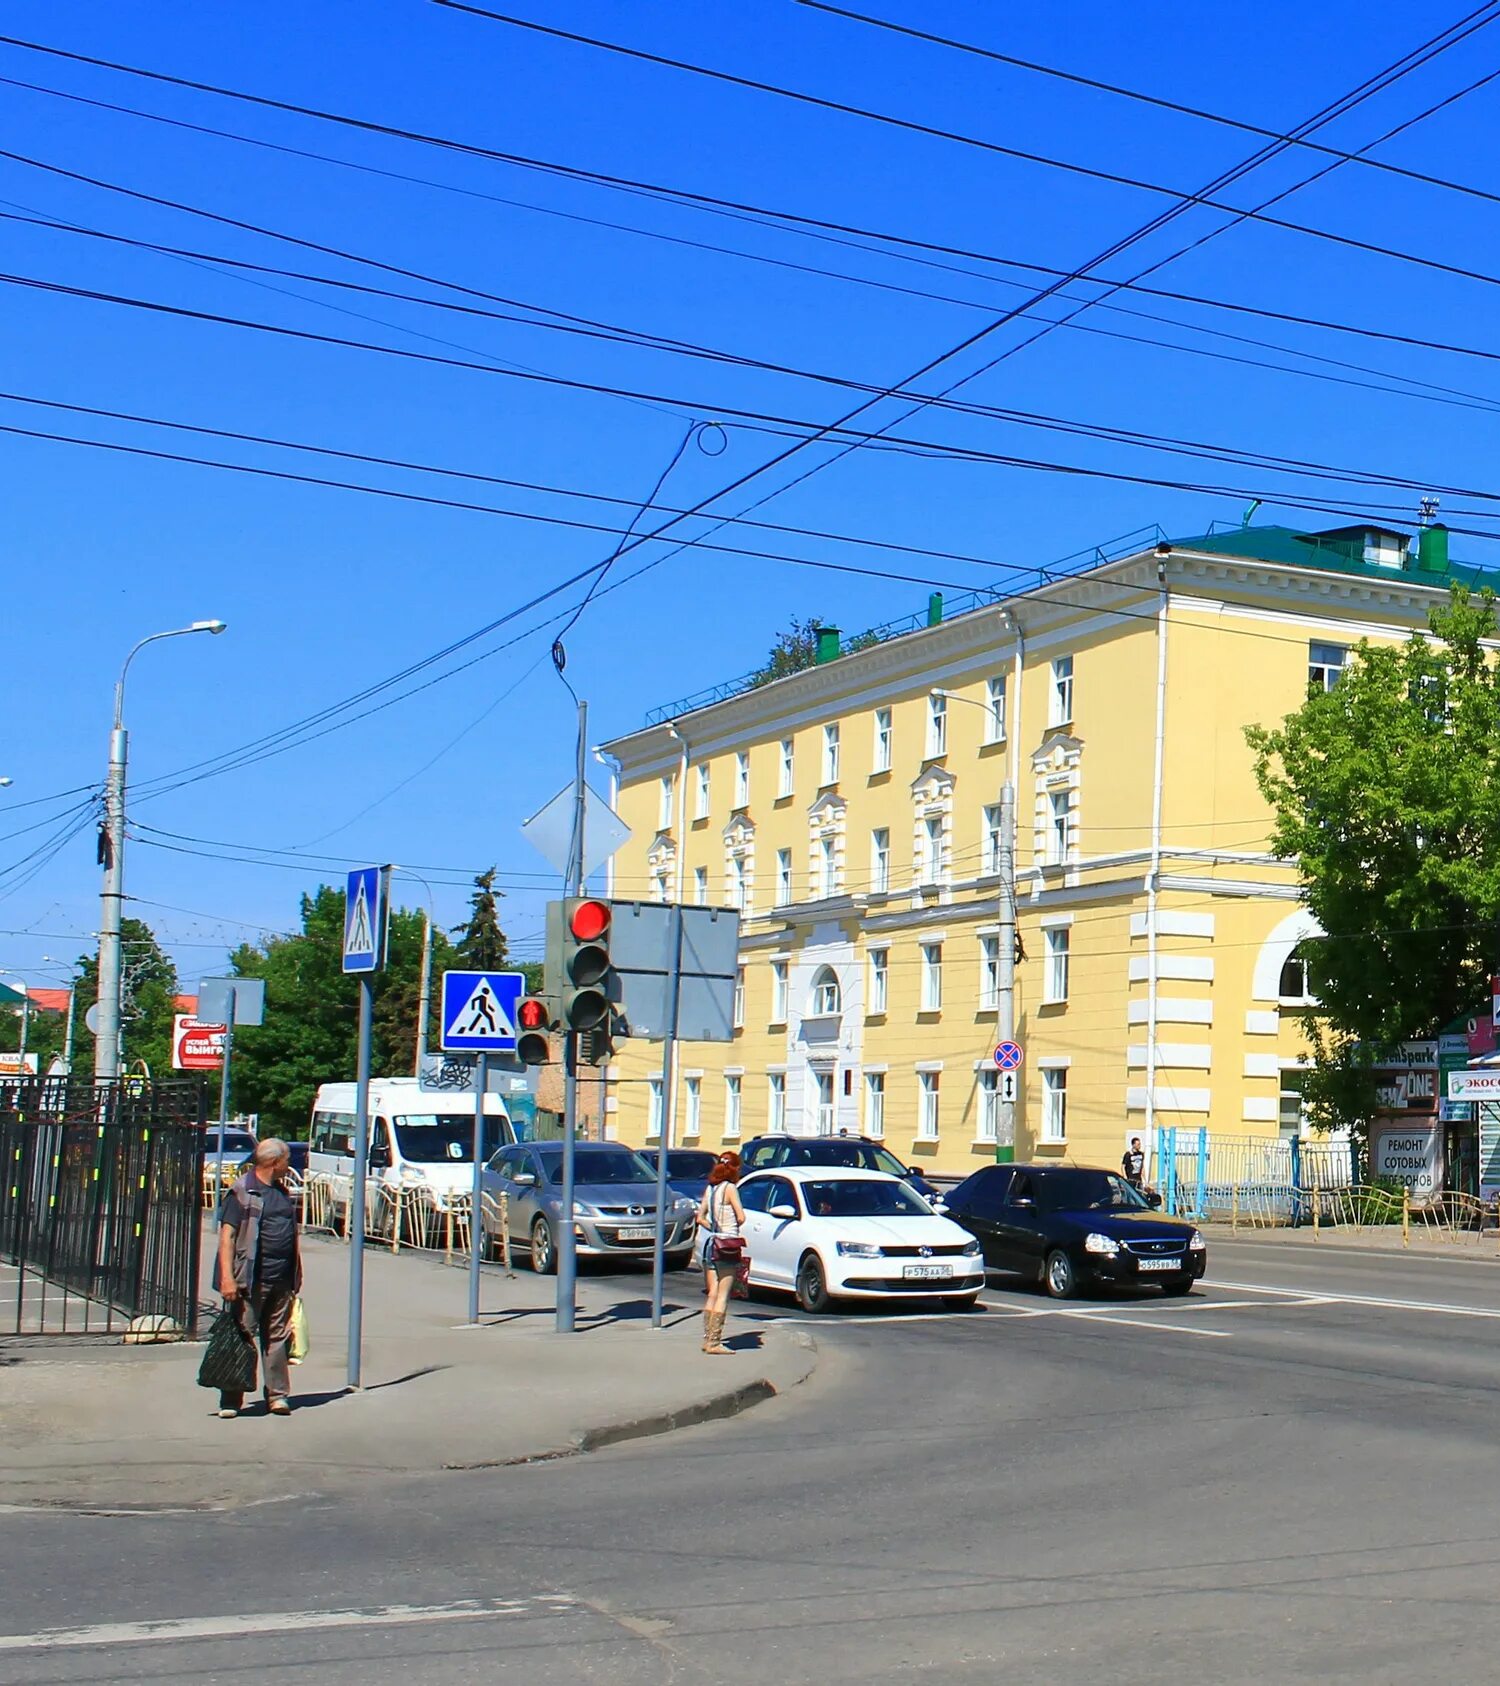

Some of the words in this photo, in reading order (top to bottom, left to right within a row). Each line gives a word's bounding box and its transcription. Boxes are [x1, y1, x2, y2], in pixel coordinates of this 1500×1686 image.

[449, 1142, 463, 1158] 6
[1388, 1139, 1423, 1151] РЕМОНТ
[1384, 1157, 1427, 1169] СОТОВЫХ
